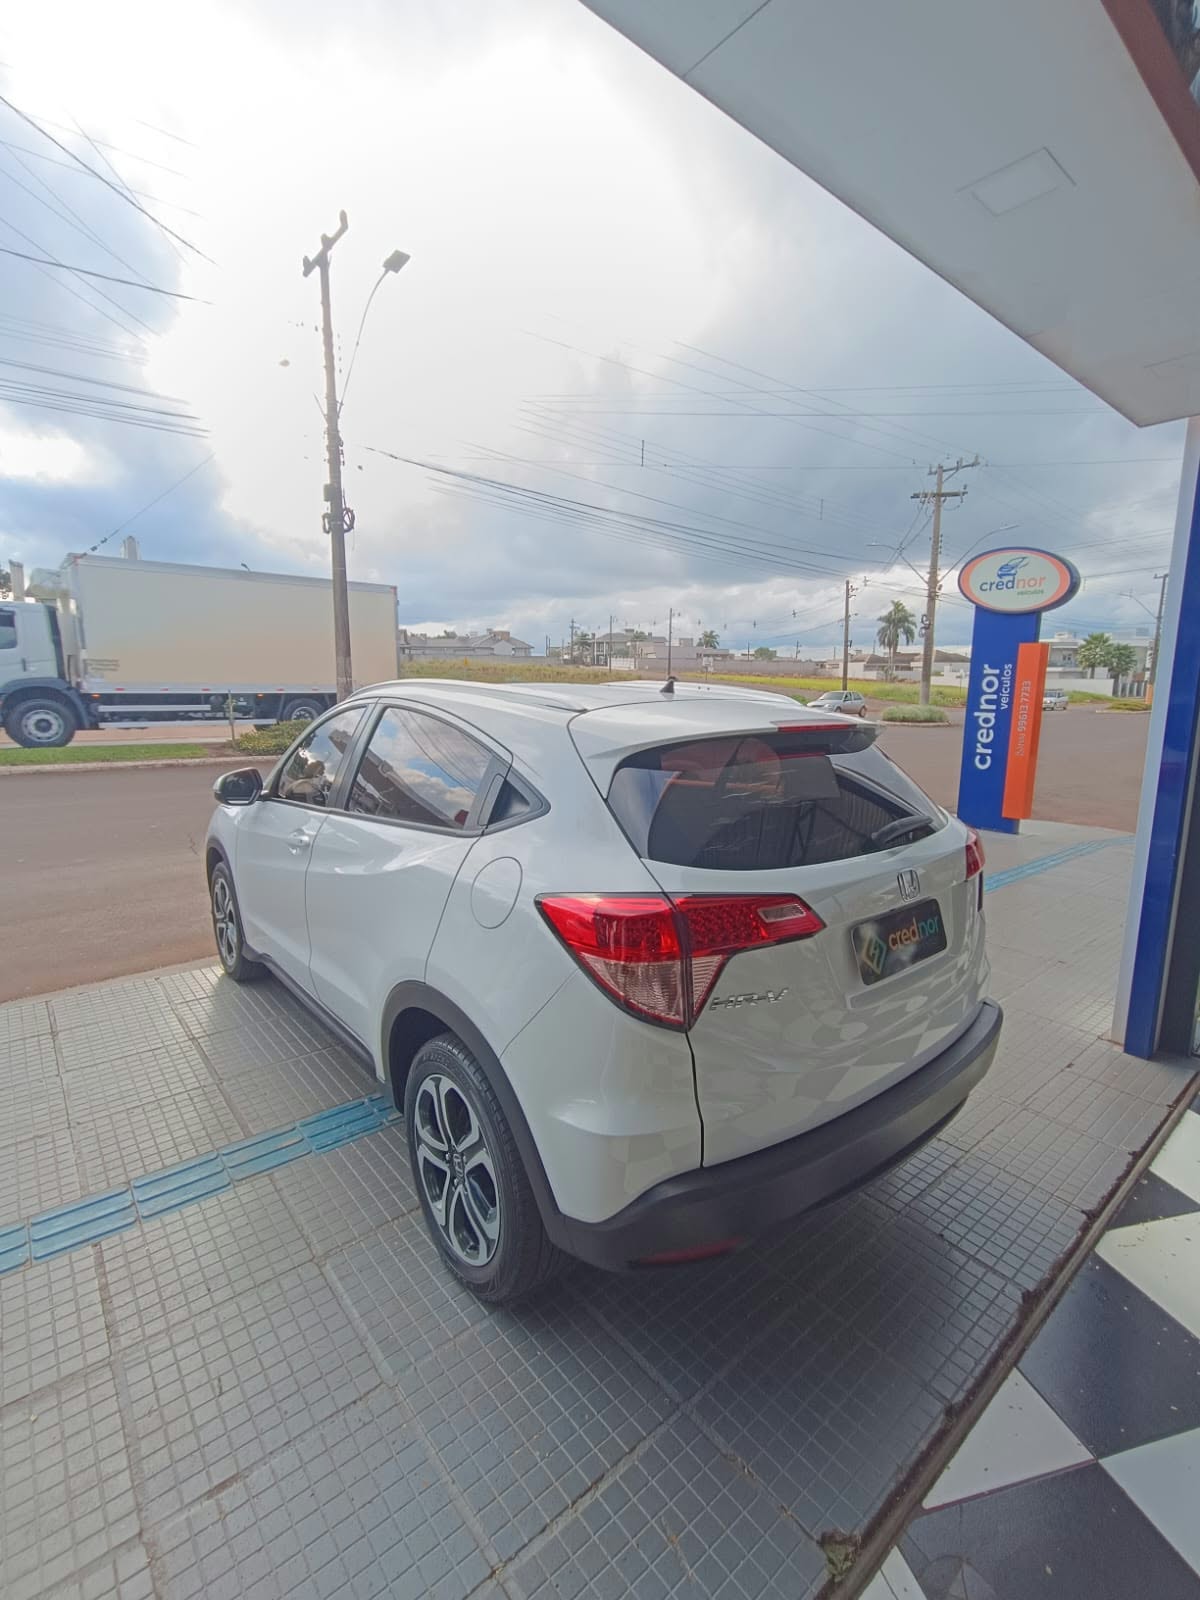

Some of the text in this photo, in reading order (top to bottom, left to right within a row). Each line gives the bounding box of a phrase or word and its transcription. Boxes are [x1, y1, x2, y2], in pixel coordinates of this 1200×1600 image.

[979, 575, 1047, 592] crednor
[1000, 663, 1012, 710] veículos
[973, 664, 1000, 770] crednor
[888, 916, 940, 951] crednor
[709, 987, 789, 1011] HR-V
